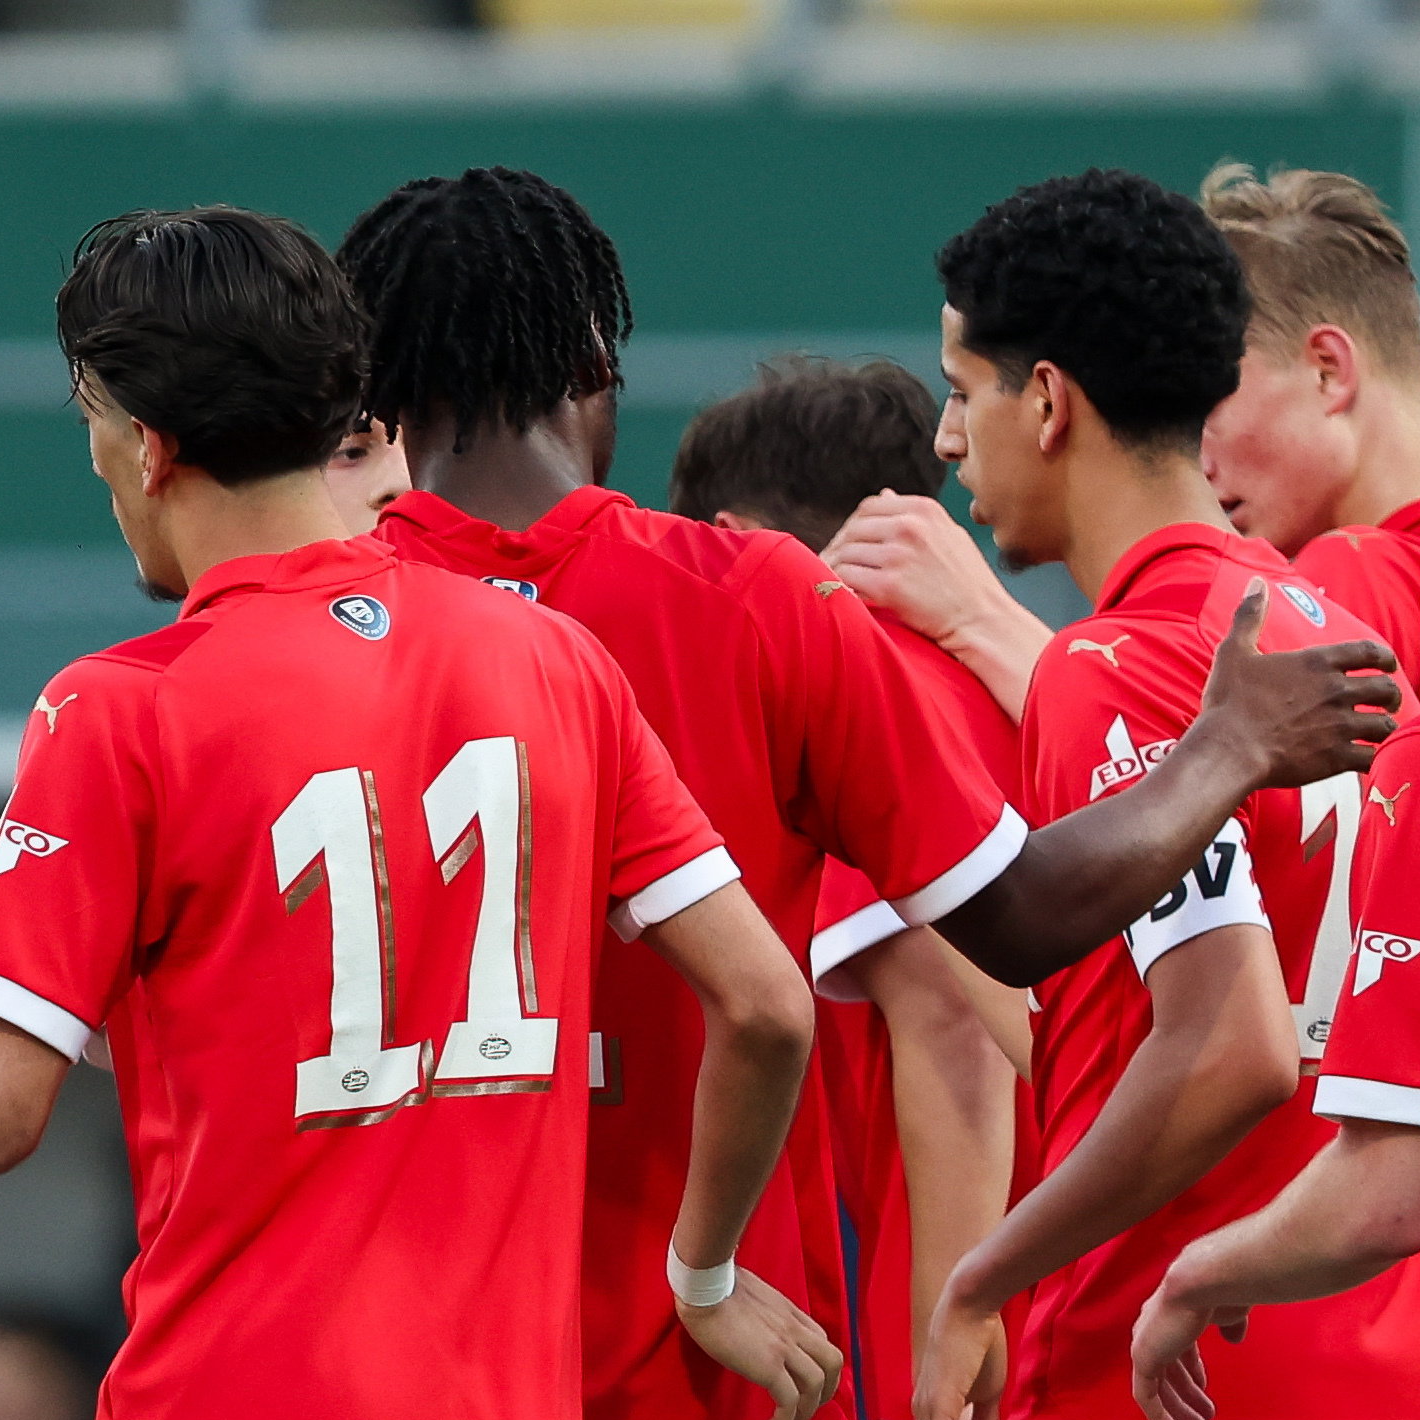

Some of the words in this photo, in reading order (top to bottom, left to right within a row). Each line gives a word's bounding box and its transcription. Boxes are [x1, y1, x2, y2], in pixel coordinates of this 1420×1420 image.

[5, 825, 50, 853] CO
[271, 736, 560, 1122] 11
[1364, 934, 1412, 958] CO
